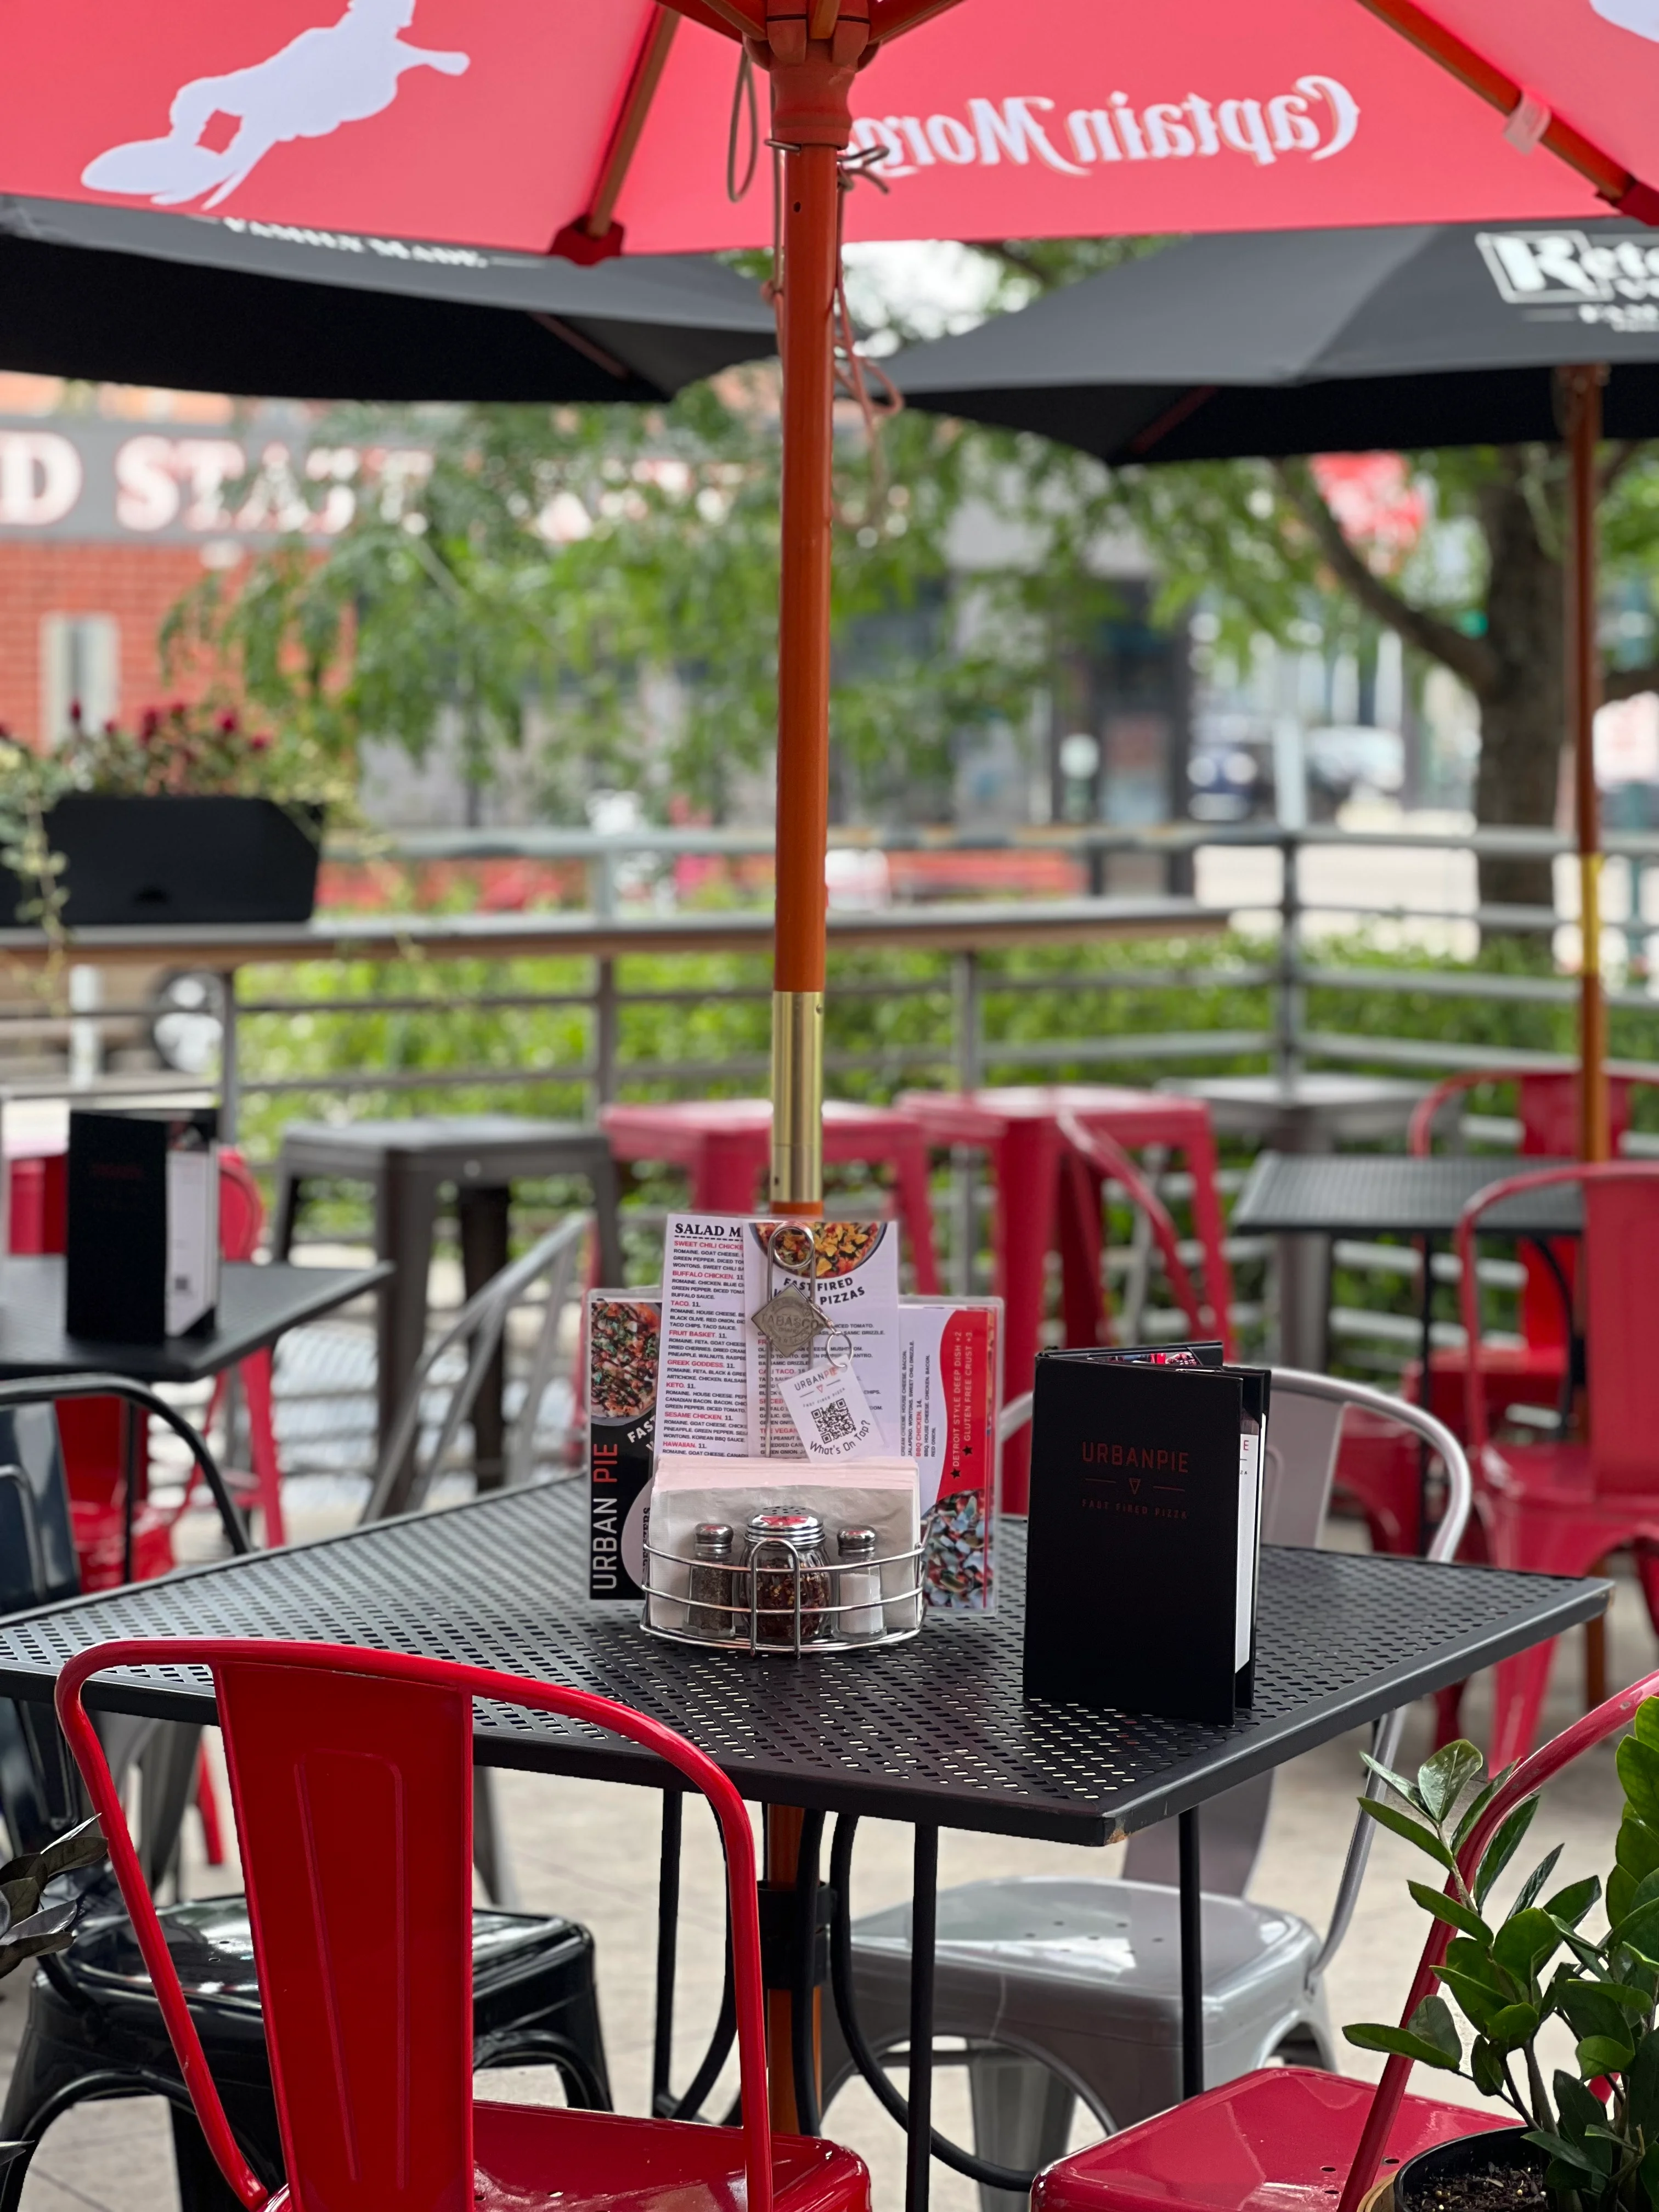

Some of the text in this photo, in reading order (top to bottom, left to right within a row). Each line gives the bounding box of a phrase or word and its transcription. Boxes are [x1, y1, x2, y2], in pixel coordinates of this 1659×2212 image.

[675, 1223, 742, 1237] SALAD M
[817, 1277, 853, 1291] FIRED
[820, 1286, 865, 1305] PIZZAS
[794, 1366, 838, 1391] URBANPIE
[810, 1420, 871, 1455] What's On Tap?
[1082, 1441, 1189, 1473] URBANPIE
[592, 1443, 618, 1589] URBAN PIE
